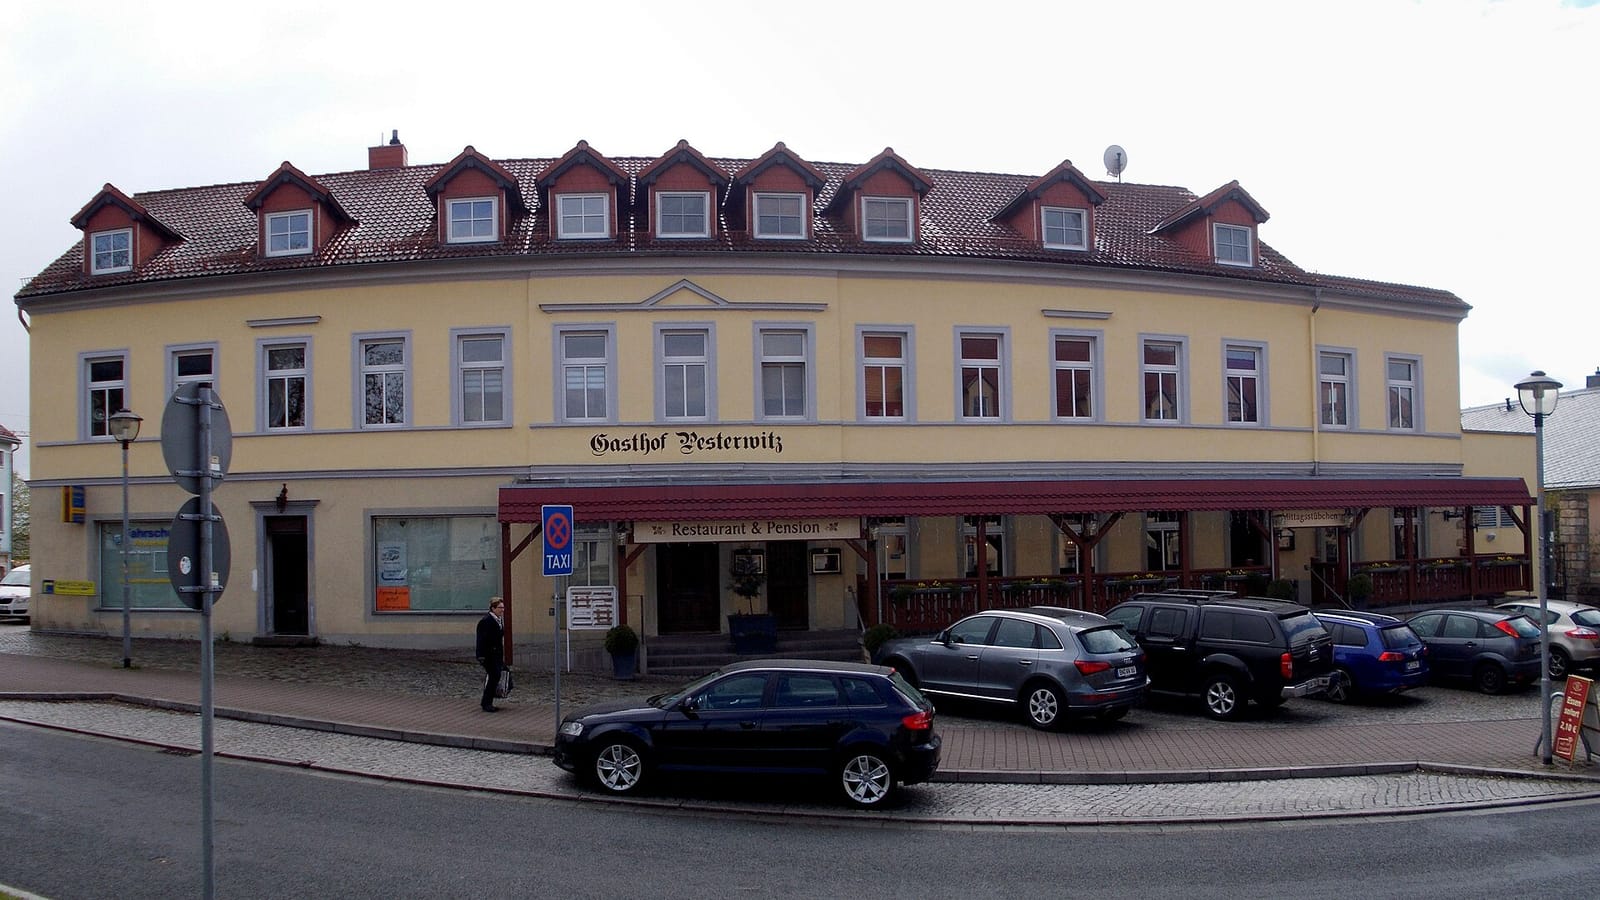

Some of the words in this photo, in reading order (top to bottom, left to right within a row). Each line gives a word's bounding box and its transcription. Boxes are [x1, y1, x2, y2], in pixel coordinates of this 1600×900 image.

[591, 432, 669, 456] Gasthof
[676, 431, 783, 455] Pesterwitz
[672, 523, 746, 536] Restaurant
[751, 522, 762, 534] &
[767, 521, 820, 534] Pension
[546, 554, 570, 569] TAXI
